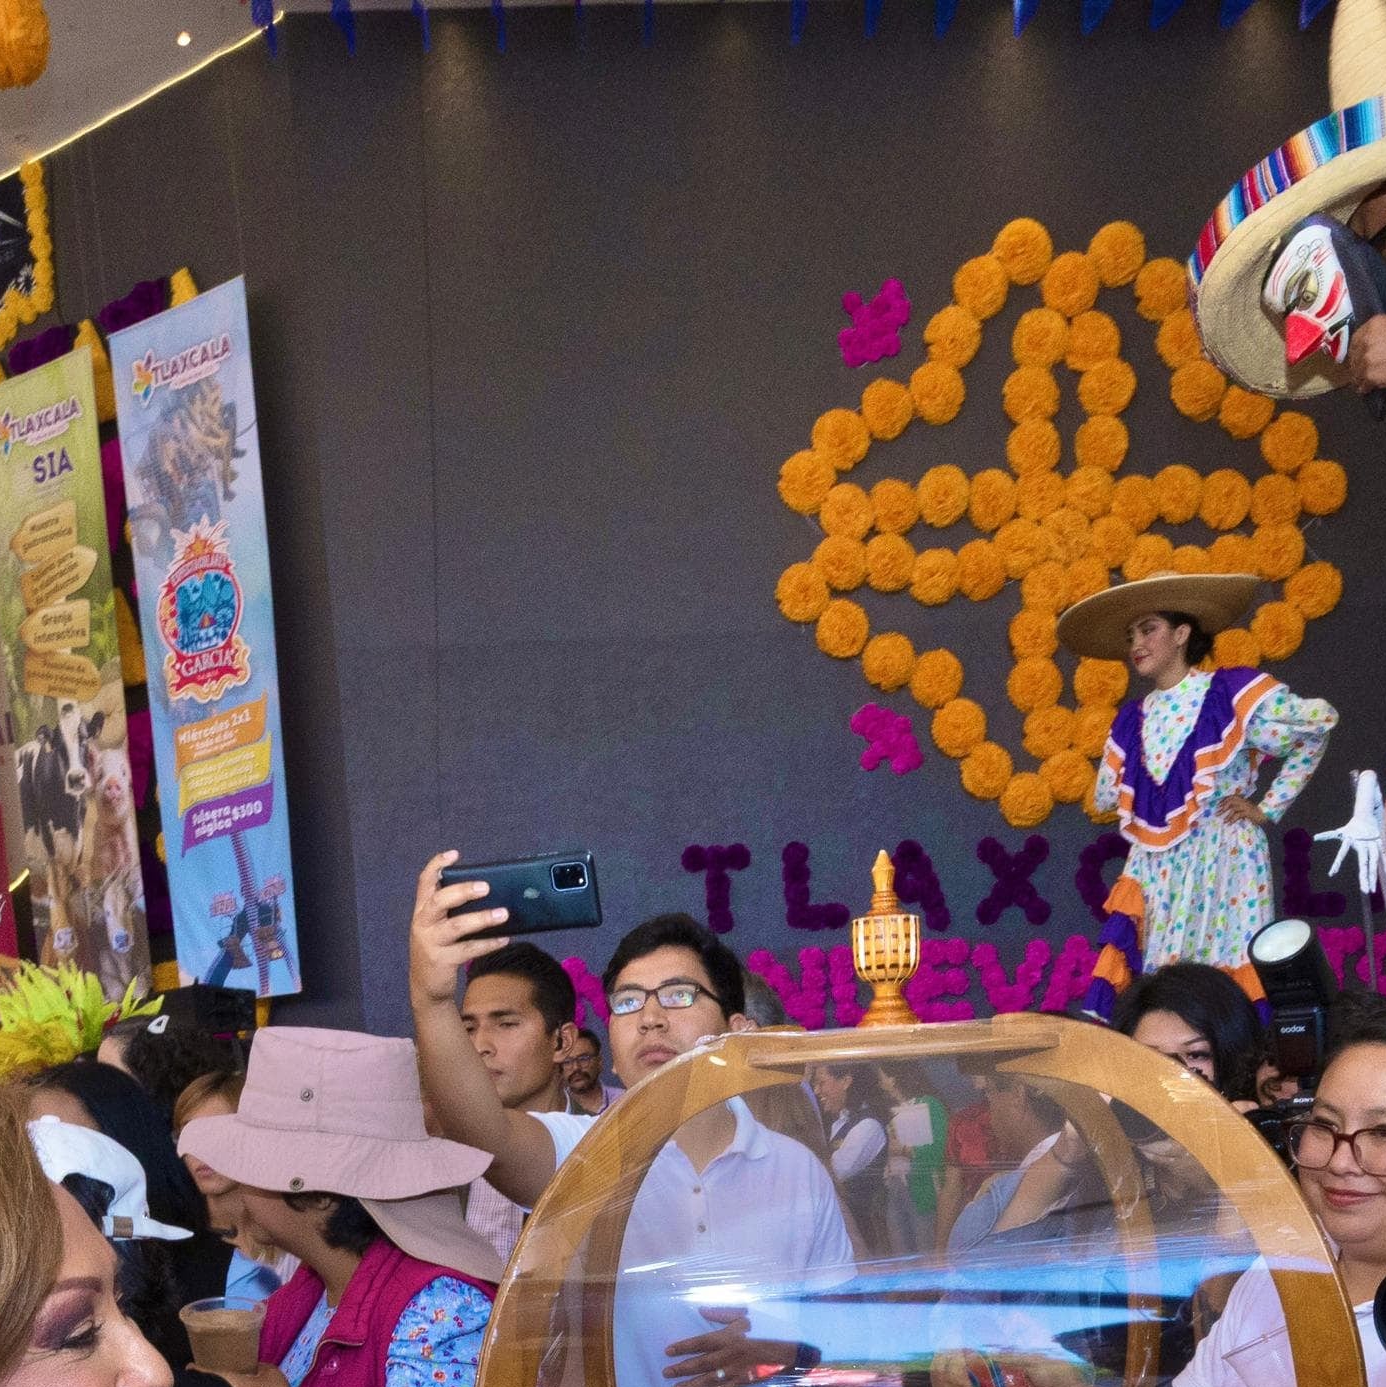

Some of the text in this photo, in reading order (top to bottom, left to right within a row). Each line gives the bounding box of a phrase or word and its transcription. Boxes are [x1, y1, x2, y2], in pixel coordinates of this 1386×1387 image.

[153, 335, 231, 382] TLAXCALA
[10, 399, 81, 441] TLAXCALA
[32, 447, 73, 484] SIA
